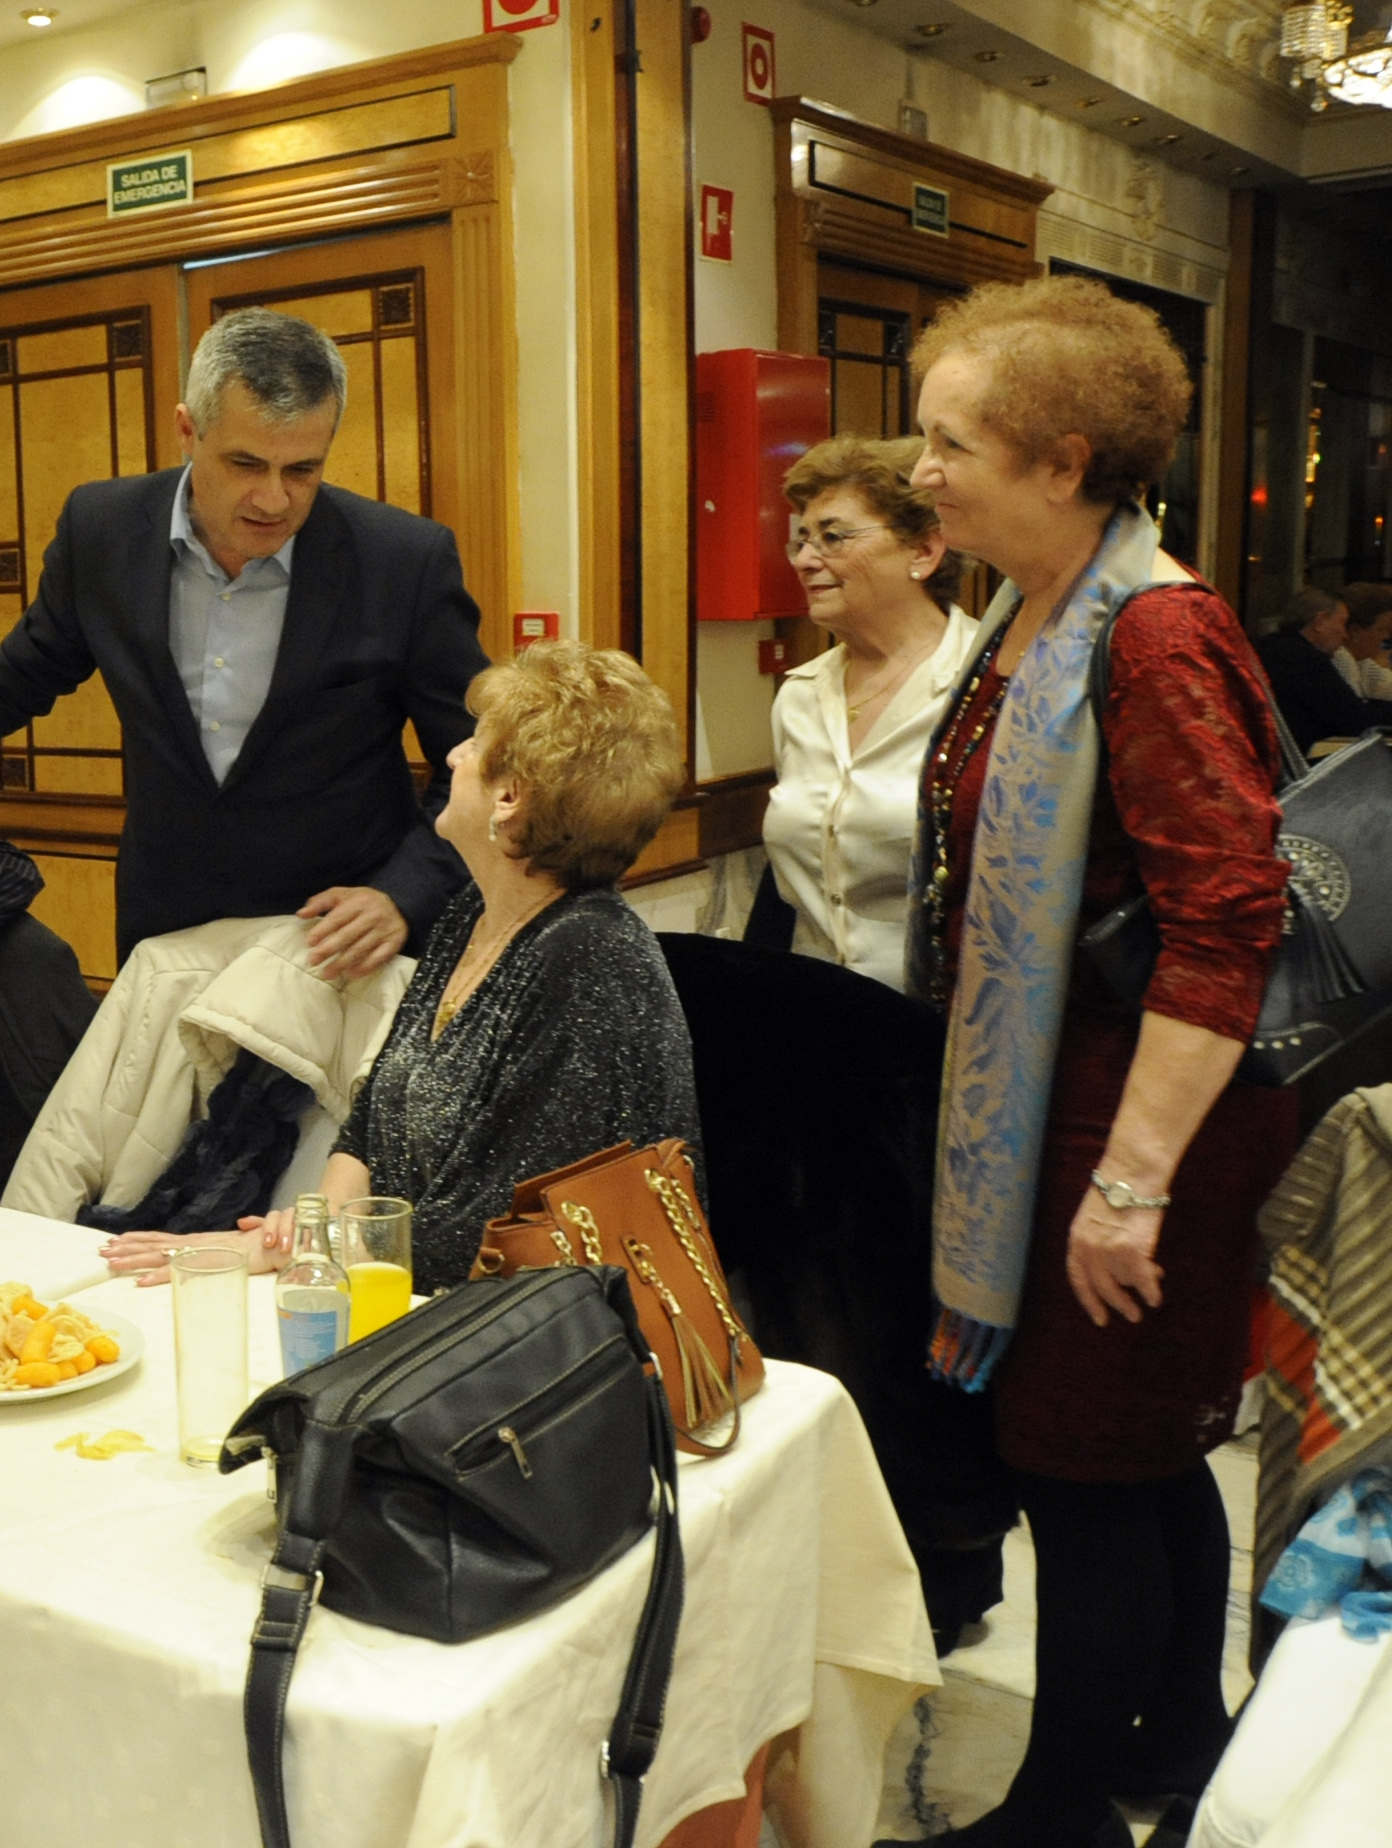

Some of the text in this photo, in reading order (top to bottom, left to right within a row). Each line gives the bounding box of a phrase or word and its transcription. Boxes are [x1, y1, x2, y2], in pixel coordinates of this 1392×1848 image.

[121, 165, 179, 188] SALIDA DE
[114, 180, 186, 205] EMERGENCIA
